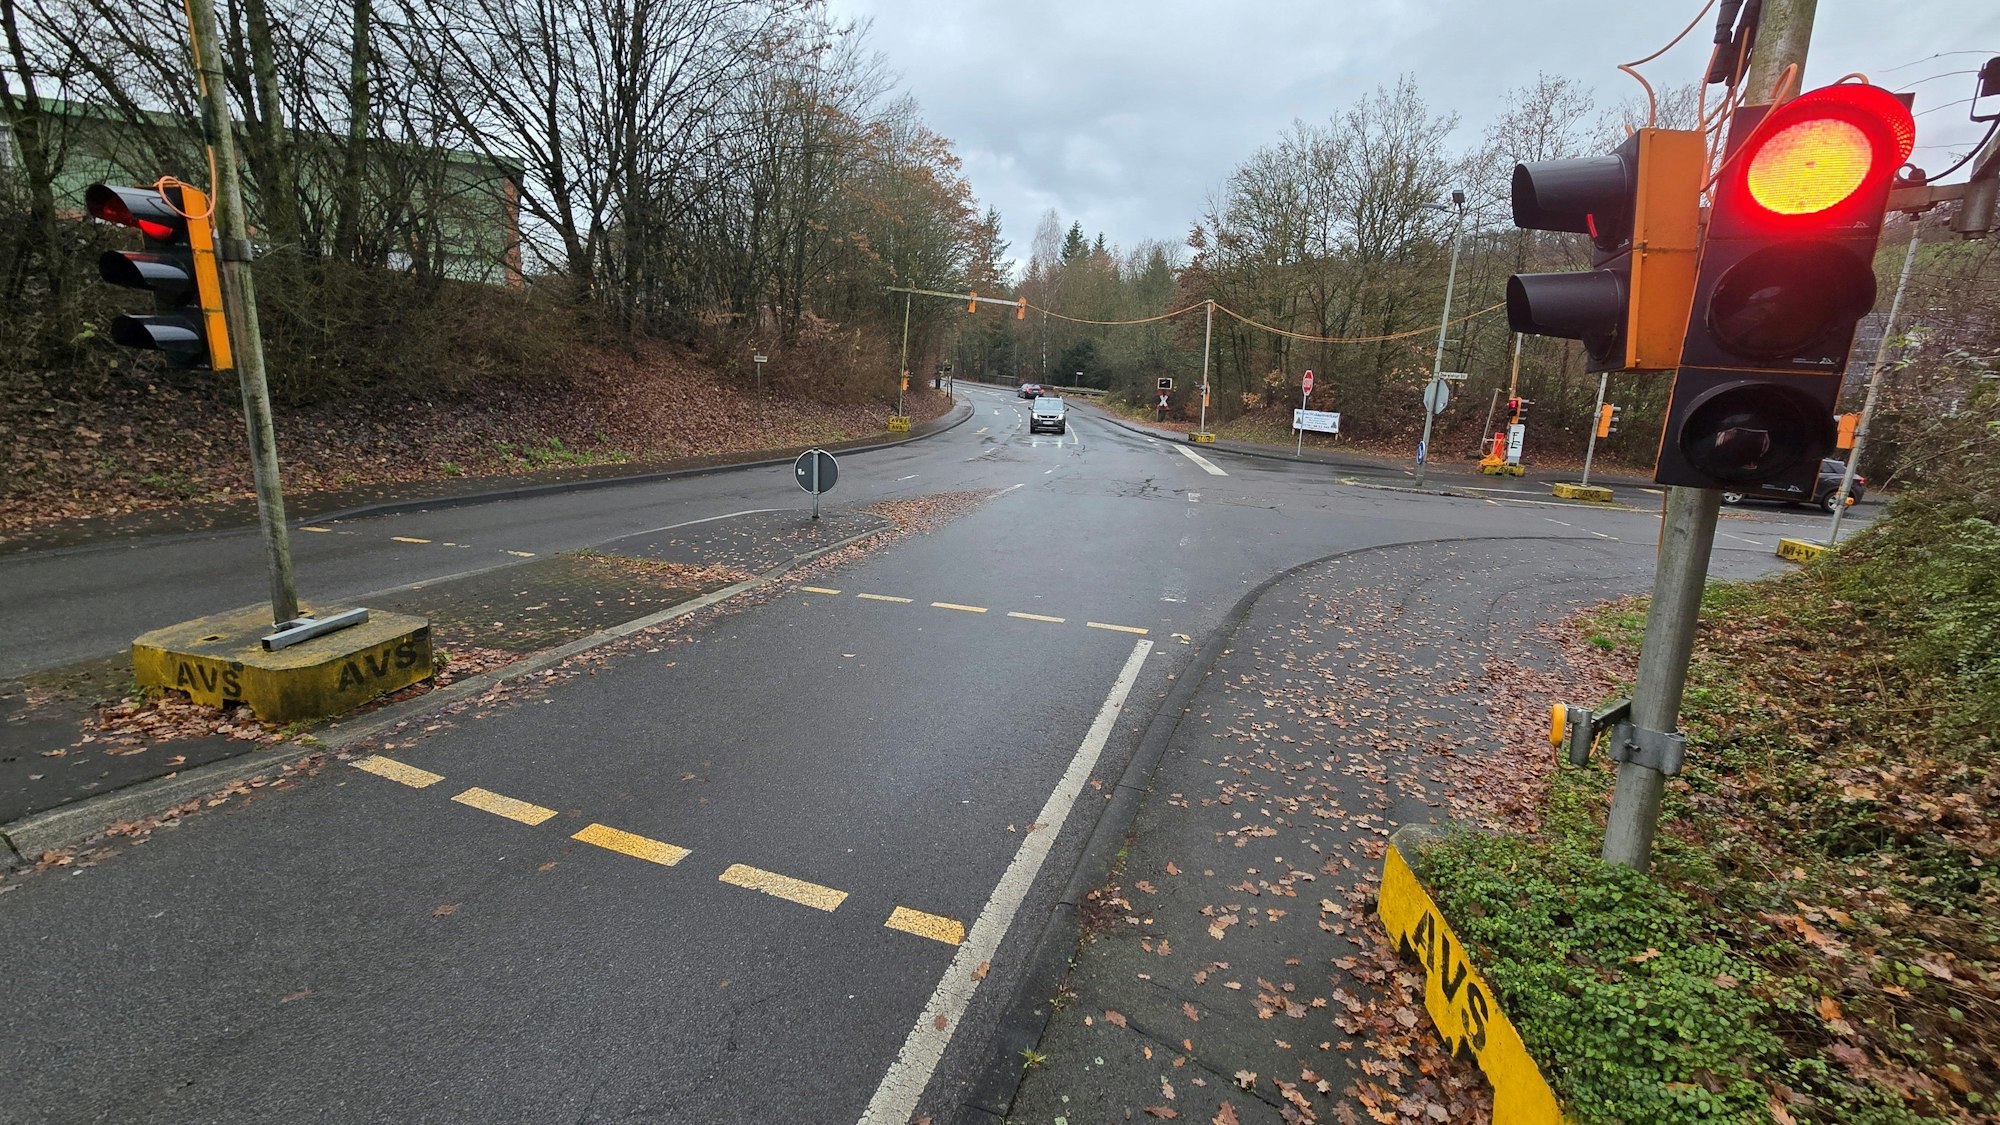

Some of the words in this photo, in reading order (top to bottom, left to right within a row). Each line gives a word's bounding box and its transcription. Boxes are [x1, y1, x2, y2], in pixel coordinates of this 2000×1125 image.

[1582, 489, 1600, 499] AVS
[1782, 545, 1815, 560] M+V
[177, 662, 242, 698] AVS
[338, 642, 417, 693] AVS
[1412, 910, 1488, 1051] AVS
